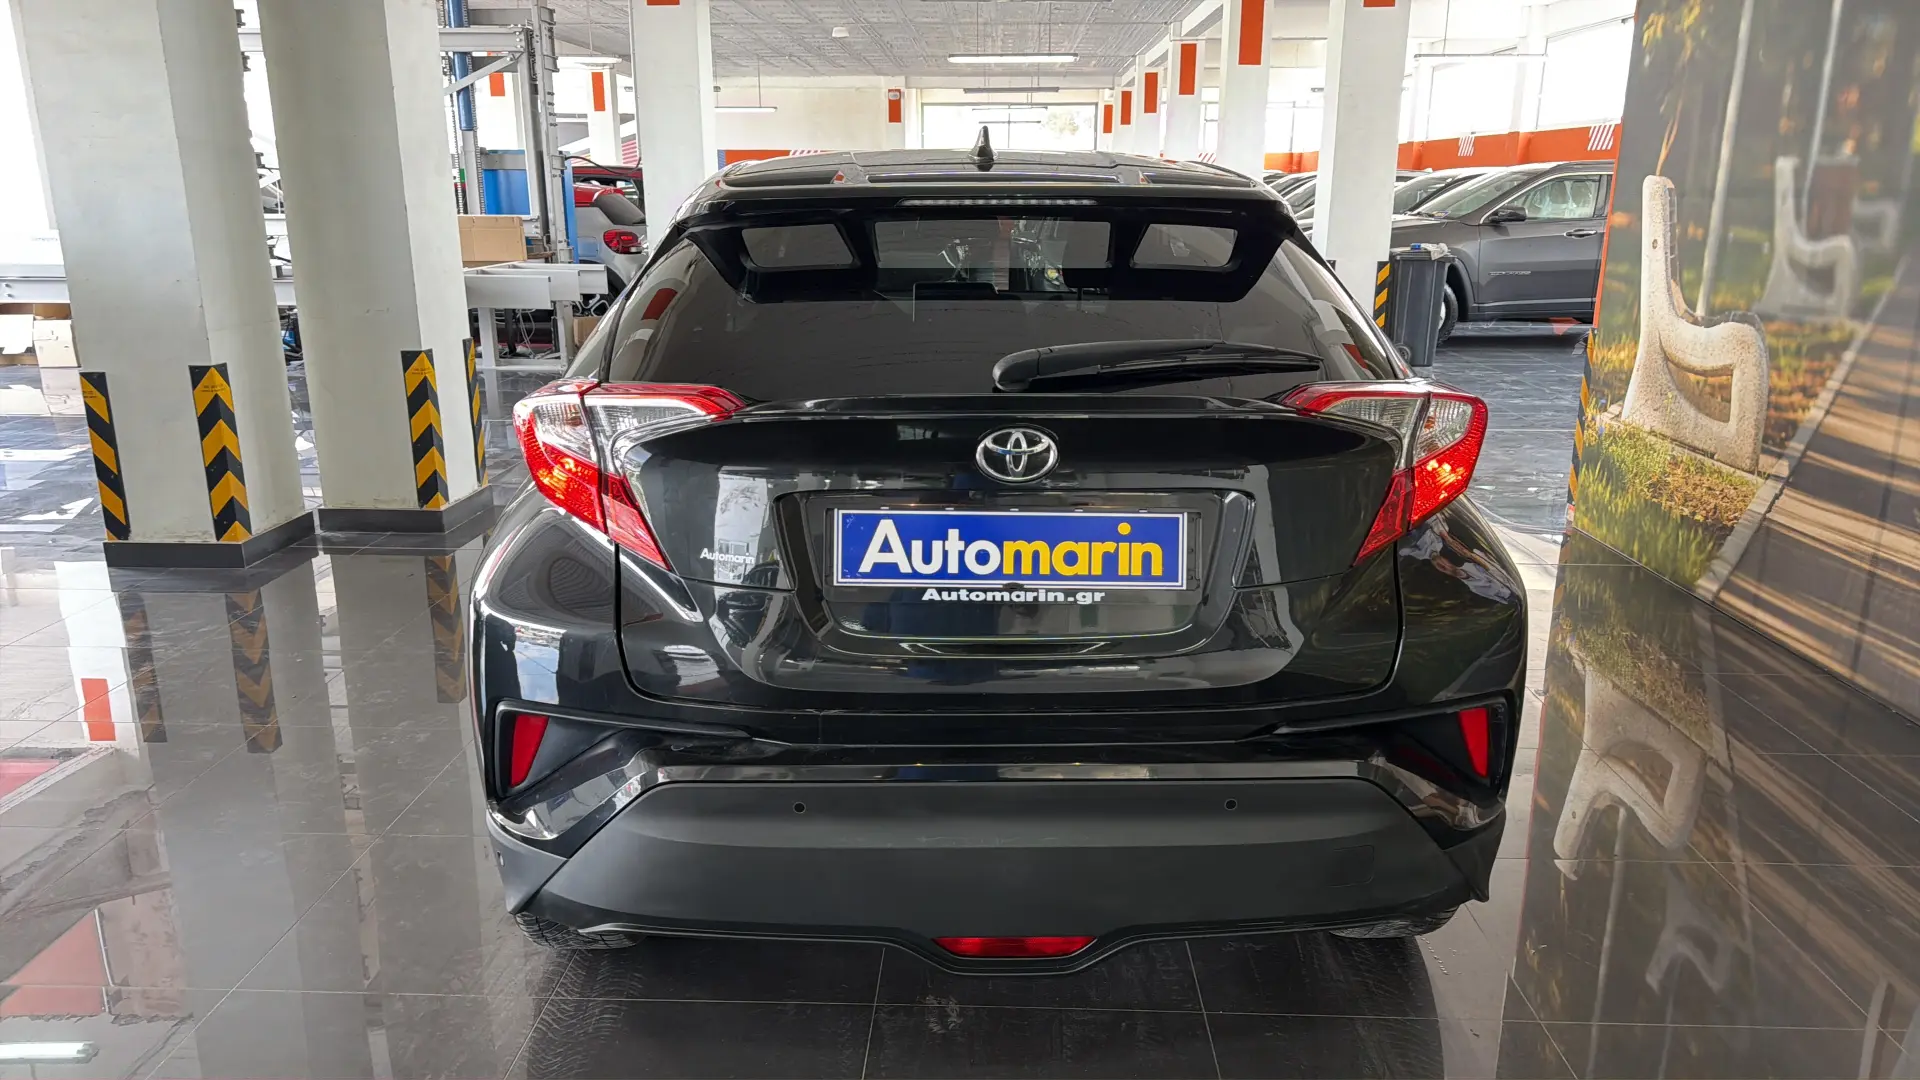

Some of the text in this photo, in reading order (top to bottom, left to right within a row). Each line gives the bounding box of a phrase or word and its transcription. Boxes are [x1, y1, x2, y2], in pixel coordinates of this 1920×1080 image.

[700, 547, 755, 564] Automarin
[858, 519, 1163, 576] Automarin
[921, 588, 1105, 604] Automarin.gr
